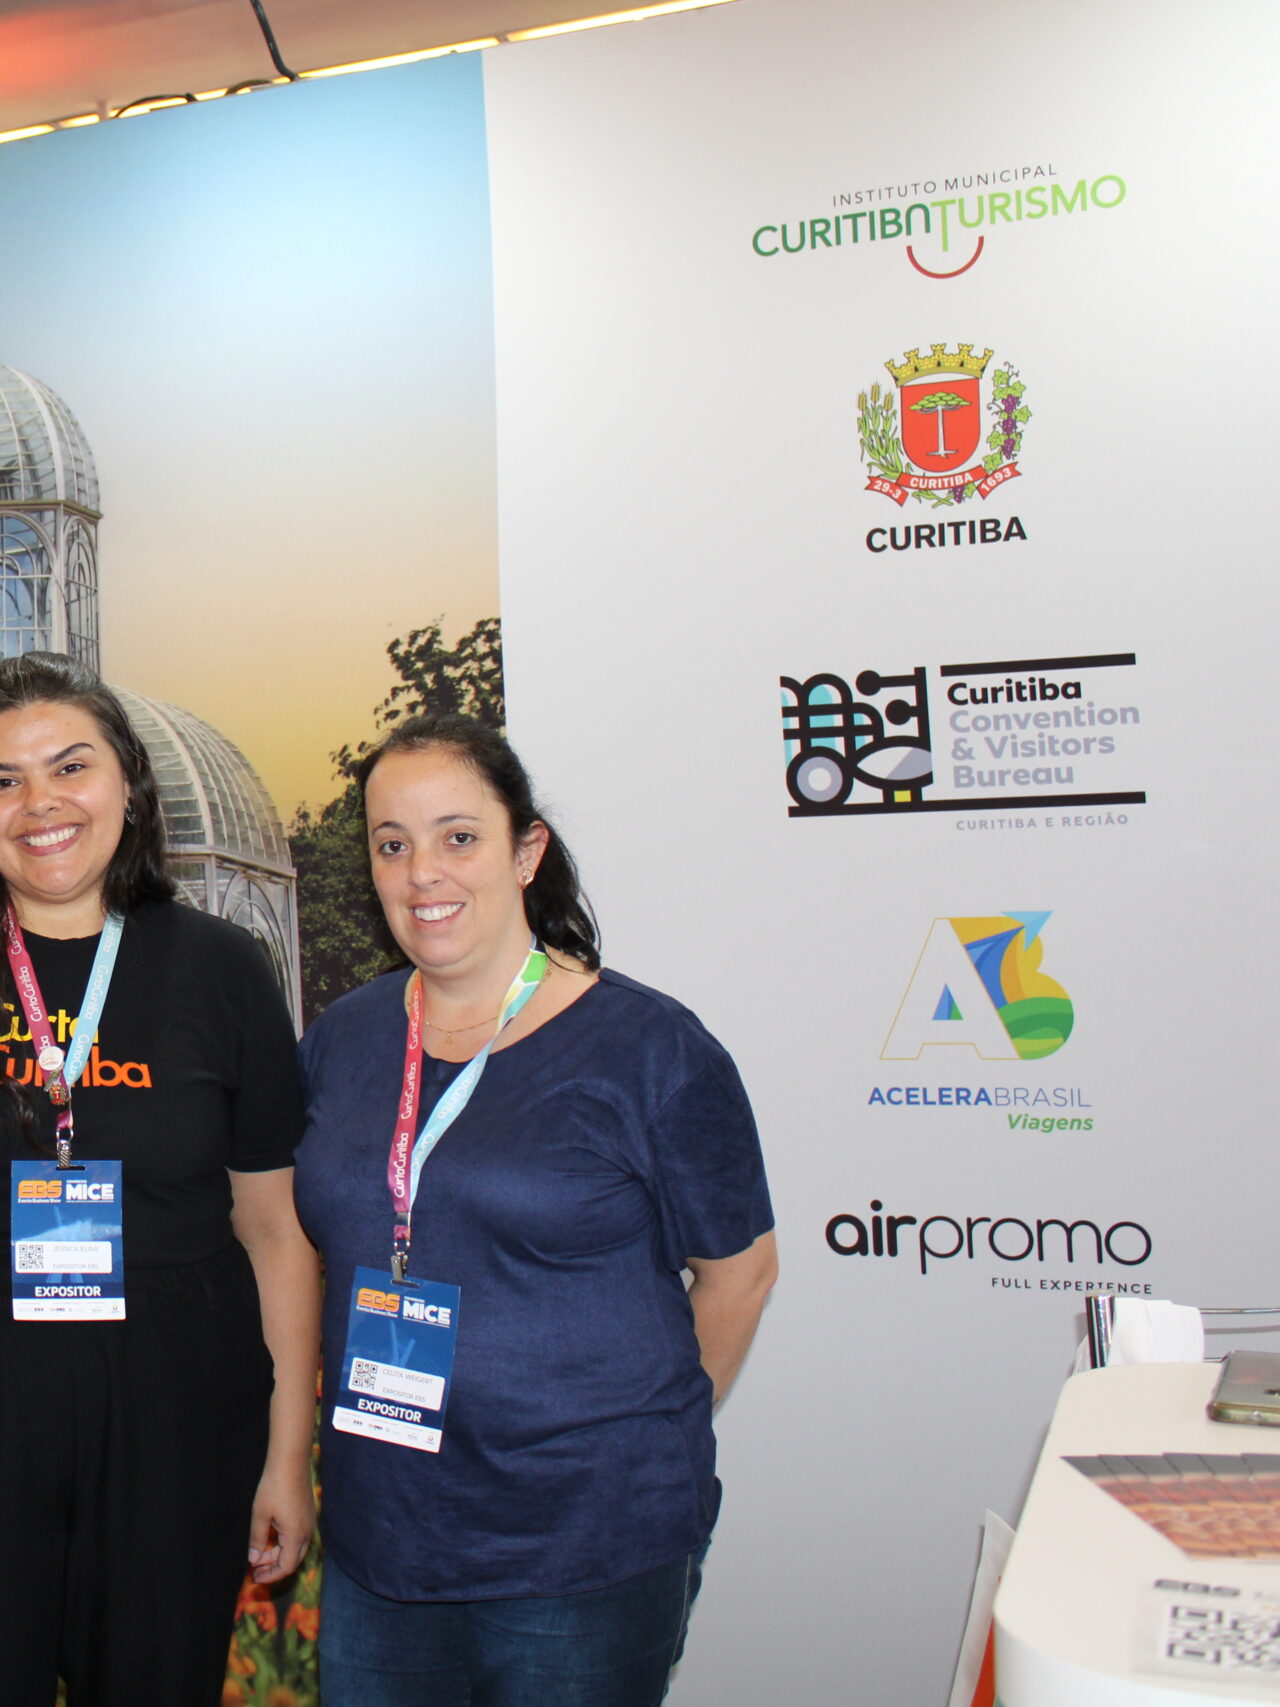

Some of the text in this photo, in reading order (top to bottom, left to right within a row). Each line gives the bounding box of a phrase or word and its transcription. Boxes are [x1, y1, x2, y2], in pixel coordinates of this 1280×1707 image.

[832, 163, 1058, 208] INSTITUTO MUNICIPAL
[873, 467, 1012, 500] 29-3 CURITIBA 1693
[865, 516, 1028, 553] CURITIBA
[946, 676, 1083, 705] Curitiba
[949, 701, 1141, 733] Convention
[950, 731, 1116, 761] & Visitors
[952, 763, 1075, 789] Bureau
[956, 811, 1130, 831] CURITIBA E REGIÃO
[401, 1061, 418, 1120] CurtaCuritiba
[1007, 1114, 1095, 1134] Viagens
[393, 1132, 410, 1198] CurtaCuritiba
[18, 1180, 114, 1200] EBS MICE
[825, 1199, 1153, 1275] airpromo
[34, 1286, 101, 1298] EXPOSITOR
[991, 1277, 1153, 1295] FULL EXPERIENCE
[357, 1287, 400, 1313] EBS
[402, 1299, 451, 1325] MICE
[358, 1398, 422, 1422] EXPOSITOR
